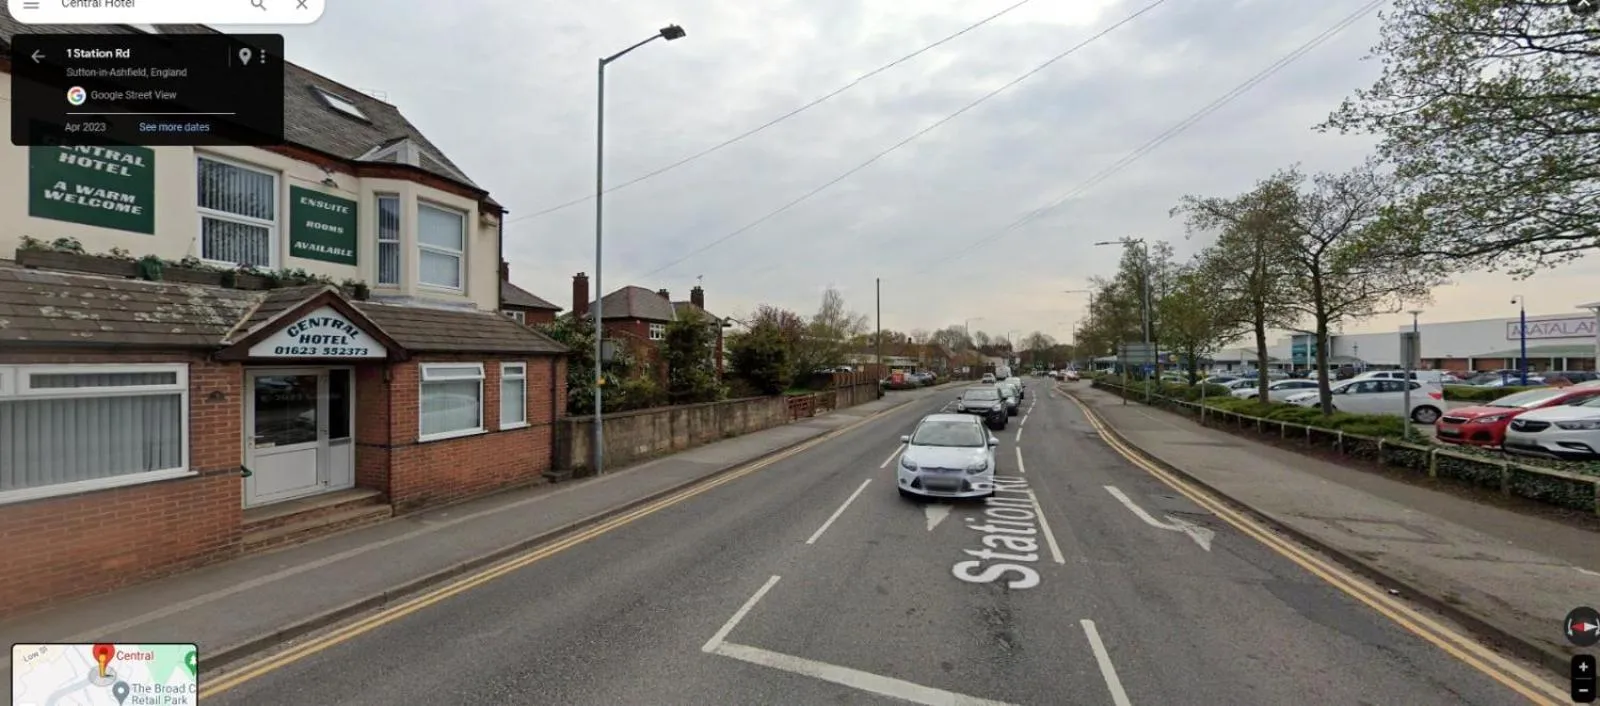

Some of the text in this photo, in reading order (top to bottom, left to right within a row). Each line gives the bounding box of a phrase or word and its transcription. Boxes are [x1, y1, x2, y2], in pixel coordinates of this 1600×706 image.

[58, 145, 146, 168] NTRAL
[58, 152, 133, 177] HOTEL
[43, 189, 145, 216] WELCOME
[53, 180, 137, 204] A WARM
[300, 196, 351, 215] ENSUITE
[305, 220, 345, 234] ROOMS
[294, 240, 354, 257] AVAILABLE
[287, 317, 360, 340] CENTRAL
[299, 334, 349, 345] HOTEL
[274, 346, 369, 356] 01623 552373
